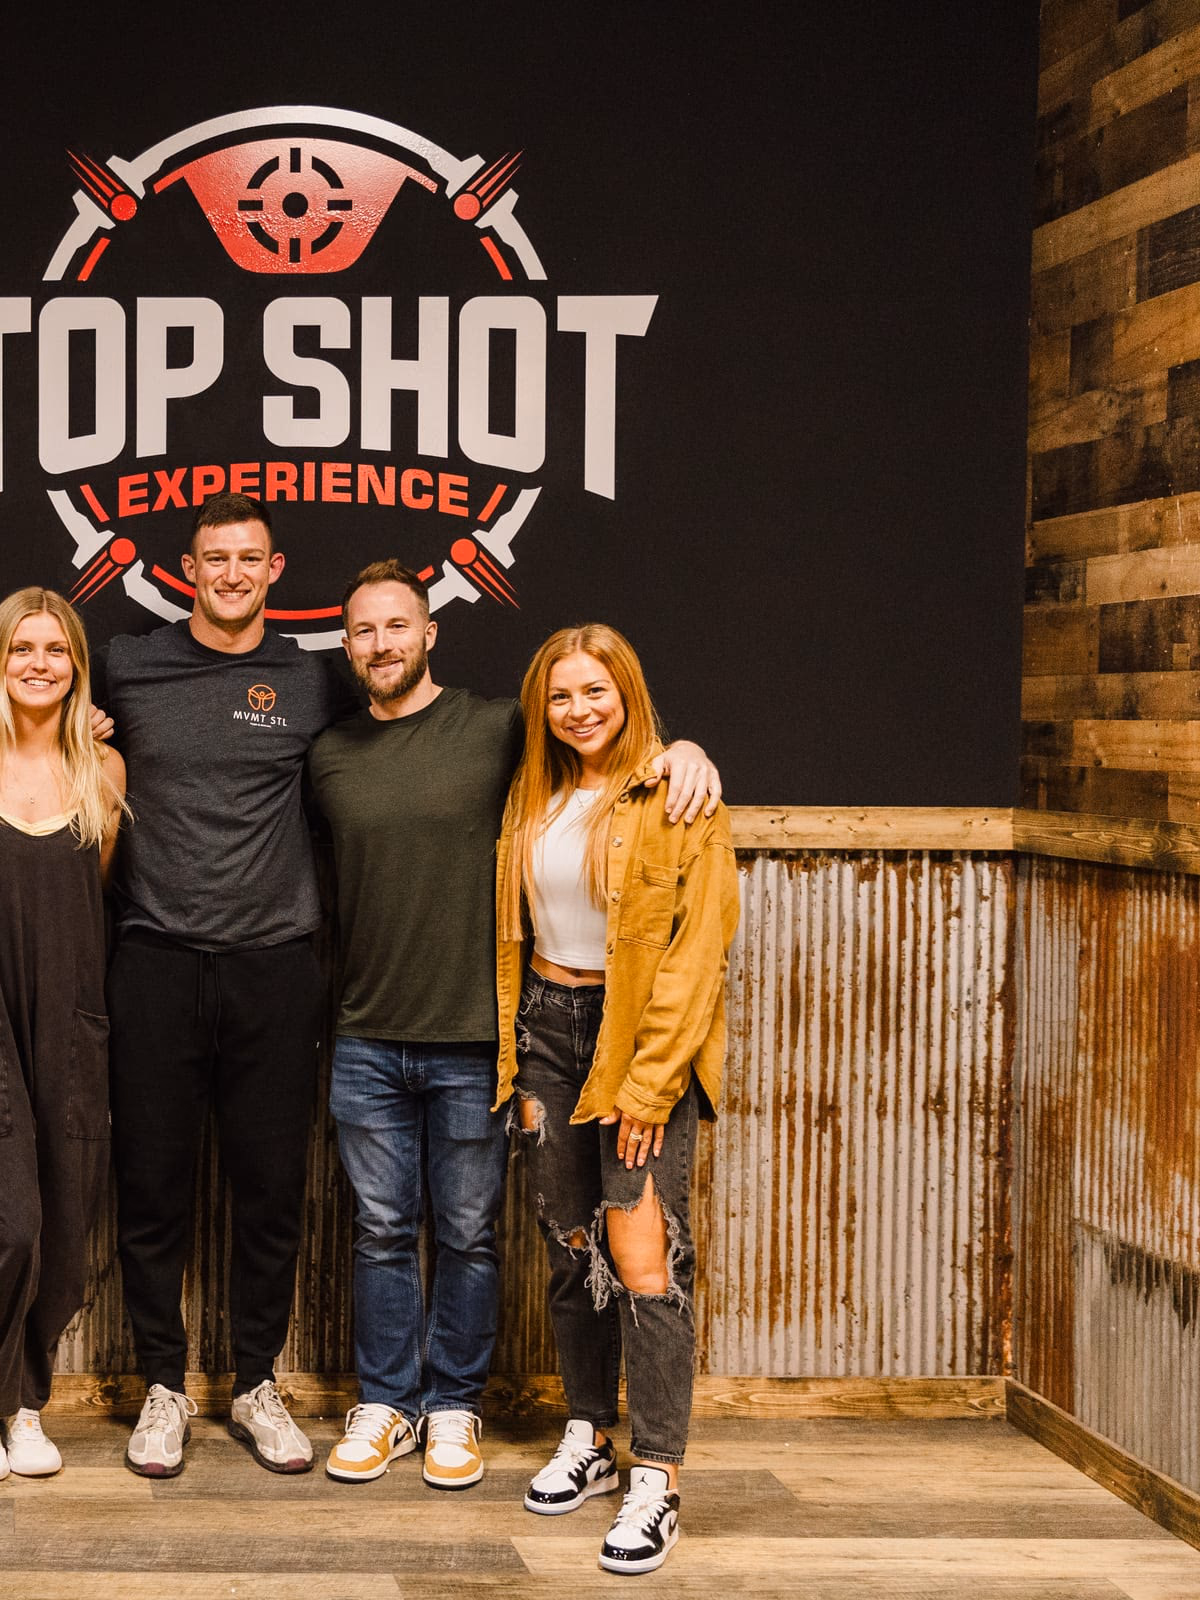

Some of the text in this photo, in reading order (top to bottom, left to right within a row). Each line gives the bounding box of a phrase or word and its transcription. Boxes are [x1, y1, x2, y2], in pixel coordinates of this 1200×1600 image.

[262, 295, 659, 500] SHOT
[118, 462, 470, 517] EXPERIENCE
[233, 710, 266, 723] MVMT
[270, 716, 288, 727] STL
